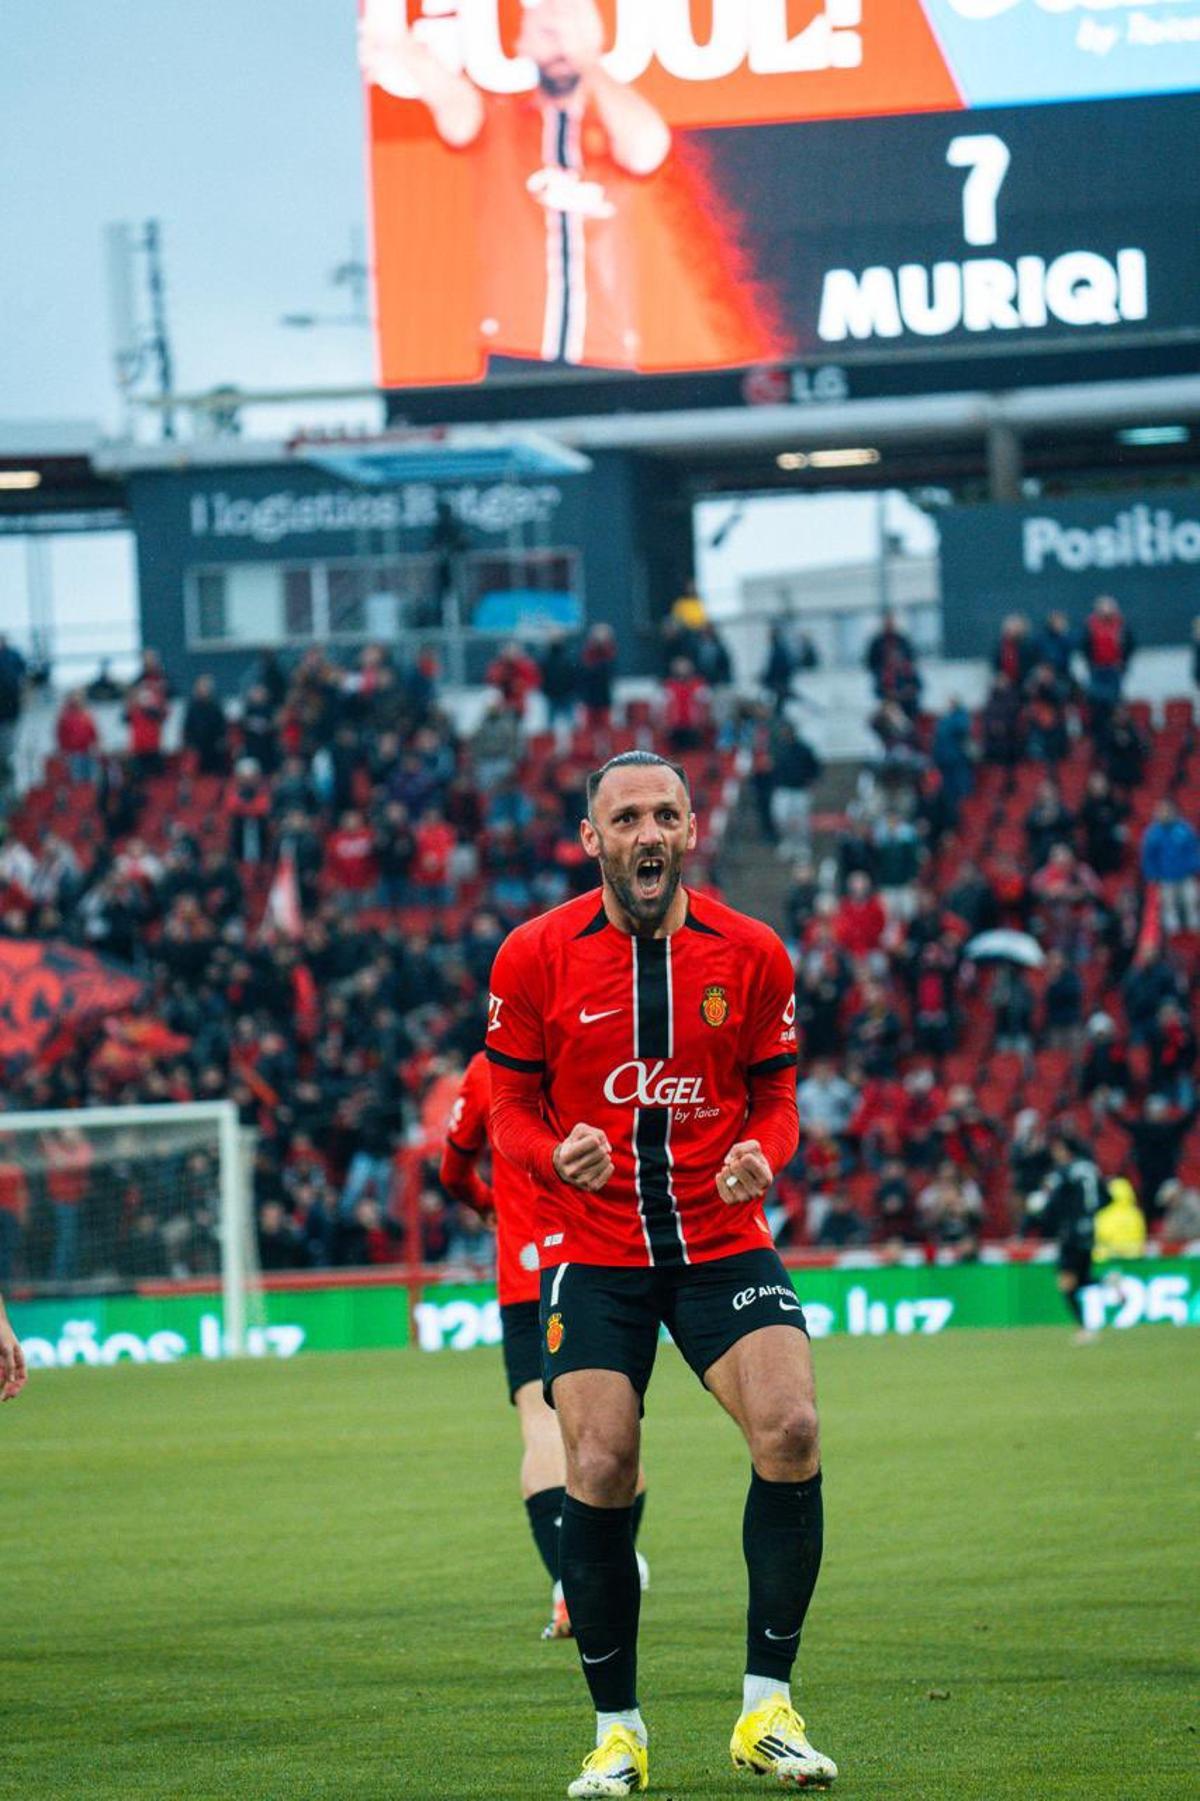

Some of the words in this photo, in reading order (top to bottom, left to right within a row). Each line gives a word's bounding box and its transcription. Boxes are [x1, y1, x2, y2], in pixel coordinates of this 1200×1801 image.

[946, 133, 1011, 246] 7
[818, 247, 1148, 342] MURIQI
[674, 1108, 691, 1124] by
